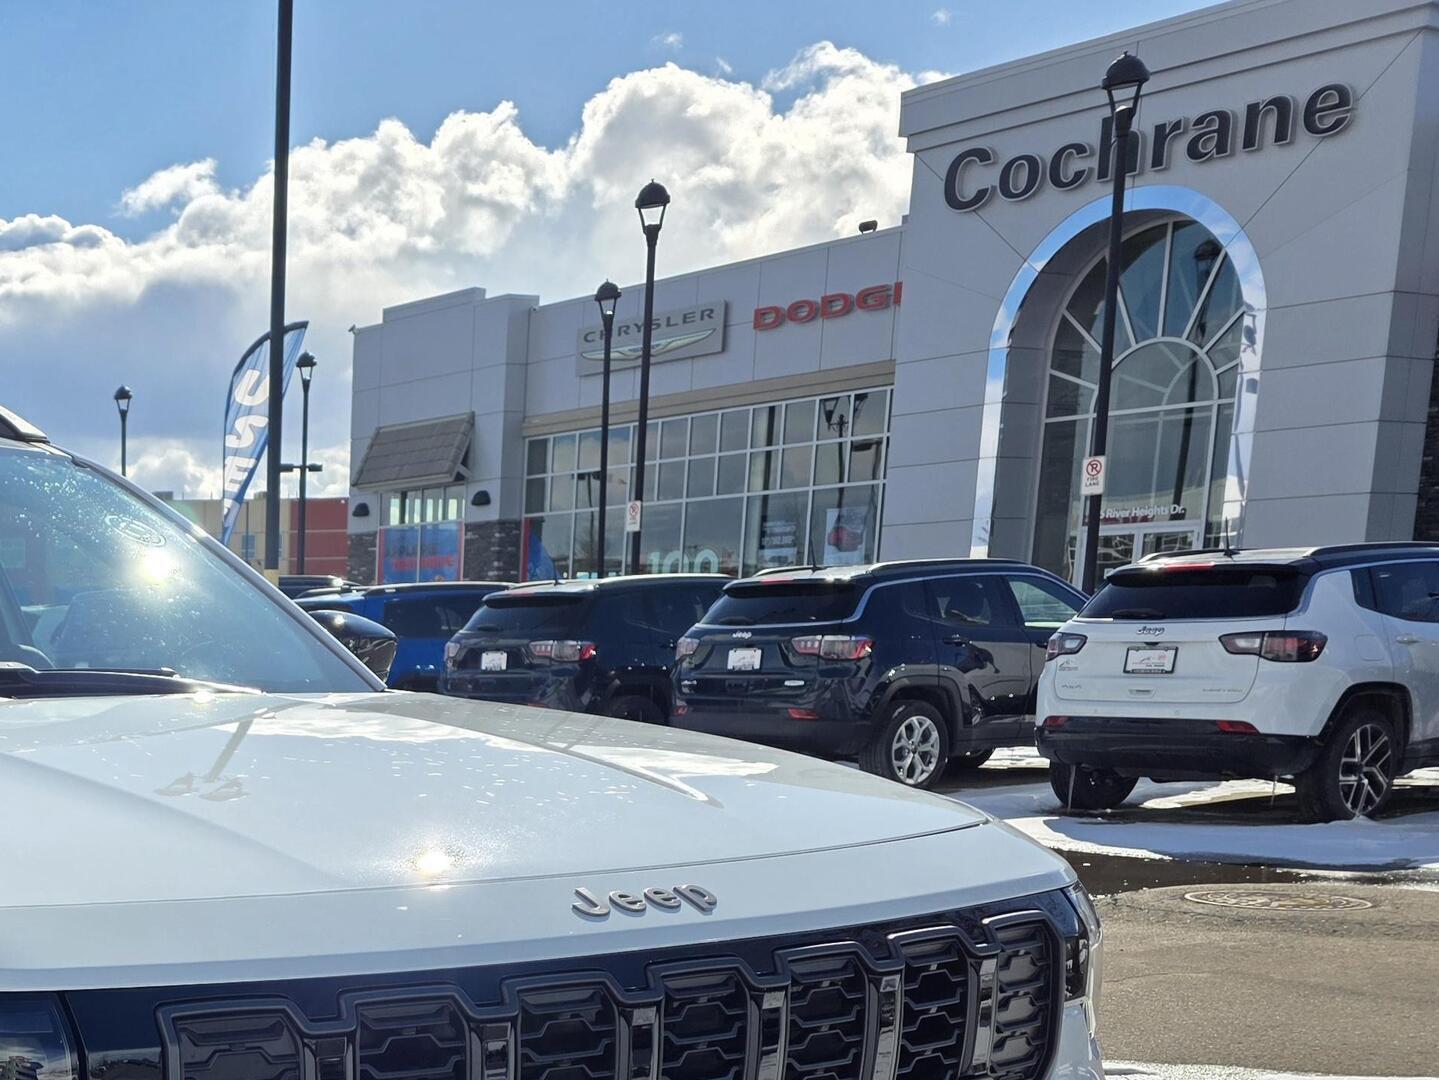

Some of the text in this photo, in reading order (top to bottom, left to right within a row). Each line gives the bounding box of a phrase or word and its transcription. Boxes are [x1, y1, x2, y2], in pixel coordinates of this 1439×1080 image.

[943, 82, 1356, 212] Cochrane
[1105, 507, 1130, 518] River
[1131, 504, 1169, 518] Heights
[1170, 503, 1185, 514] Dr.
[571, 883, 719, 918] Jeep
